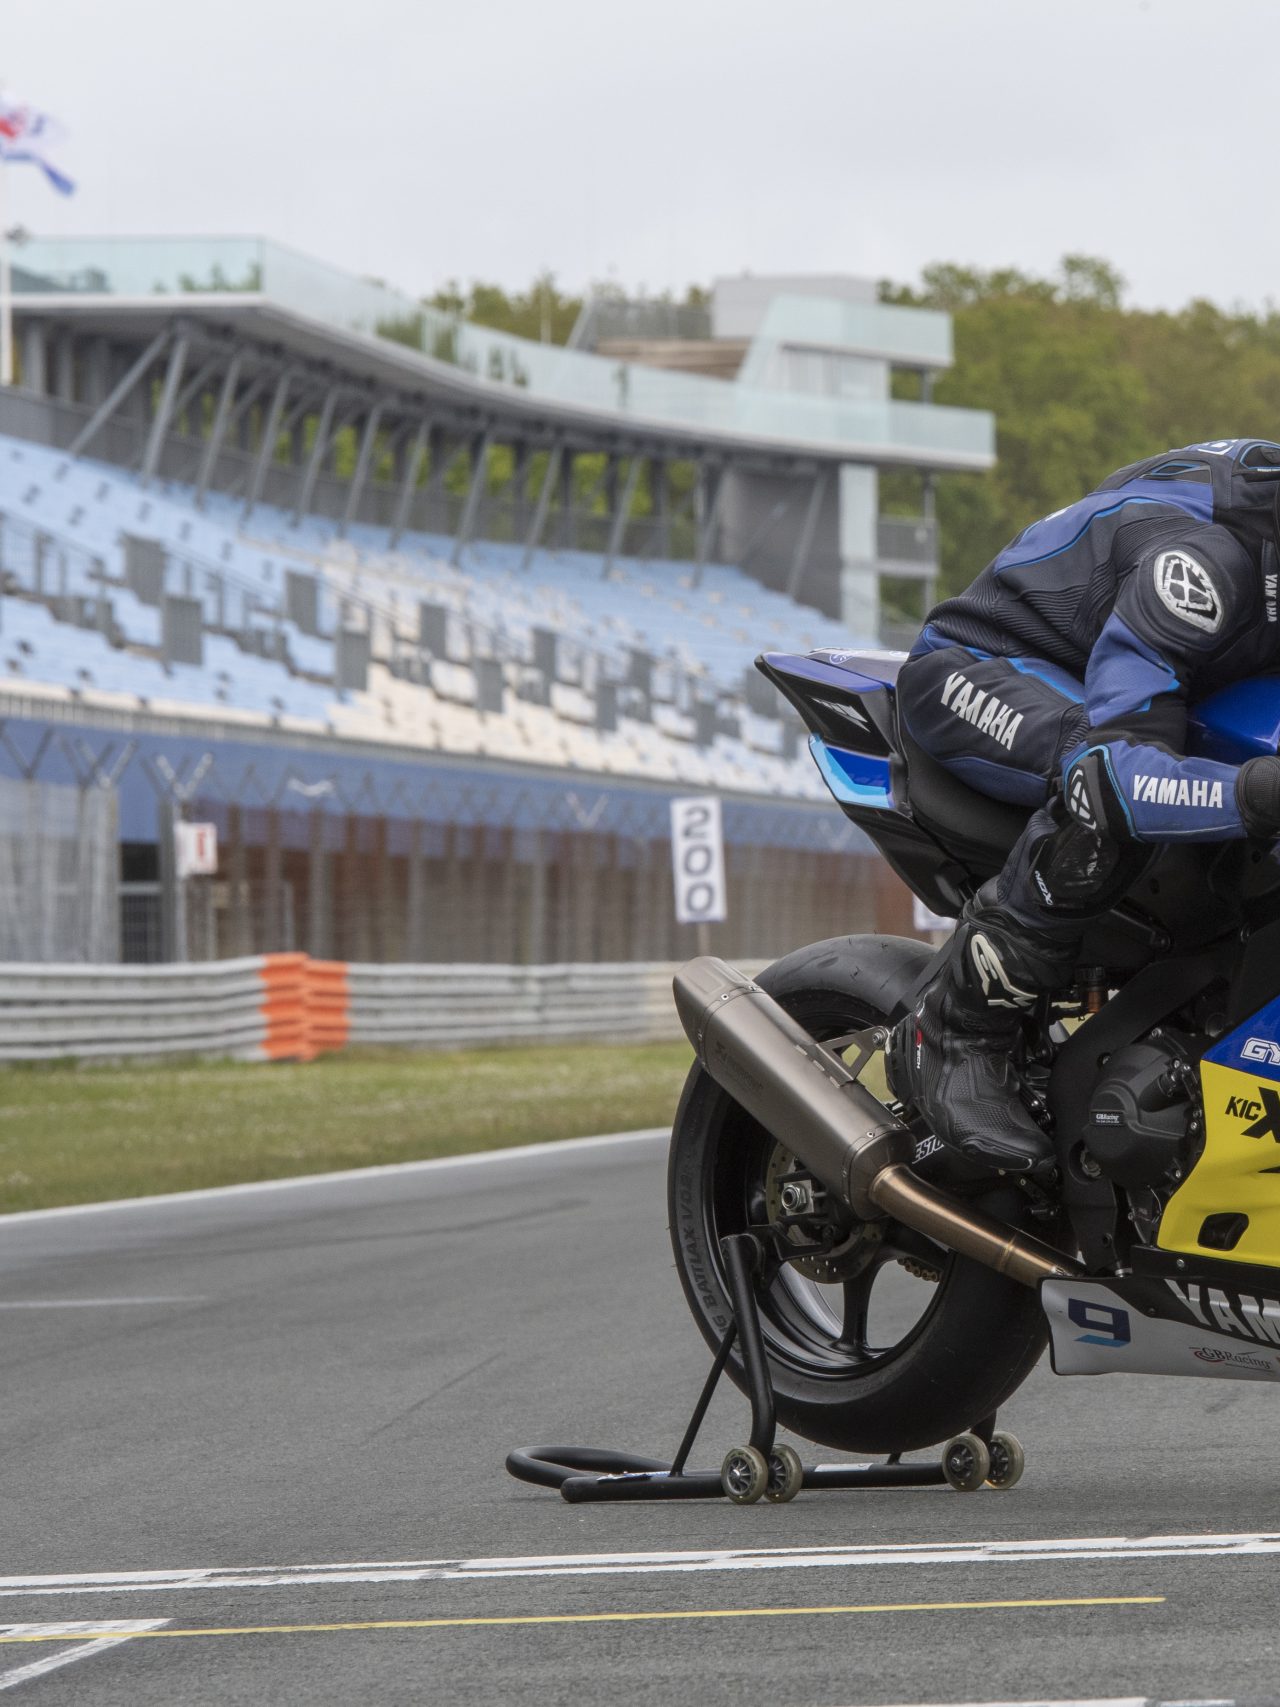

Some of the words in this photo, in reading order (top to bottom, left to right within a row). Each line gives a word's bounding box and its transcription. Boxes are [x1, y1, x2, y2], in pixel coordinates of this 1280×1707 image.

[941, 672, 1024, 750] YAMAHA
[1133, 775, 1224, 809] YAMAHA
[682, 806, 715, 915] 200
[682, 1227, 719, 1310] BATTLAX
[1068, 1298, 1131, 1348] 9
[1201, 1347, 1271, 1369] GBRacing
